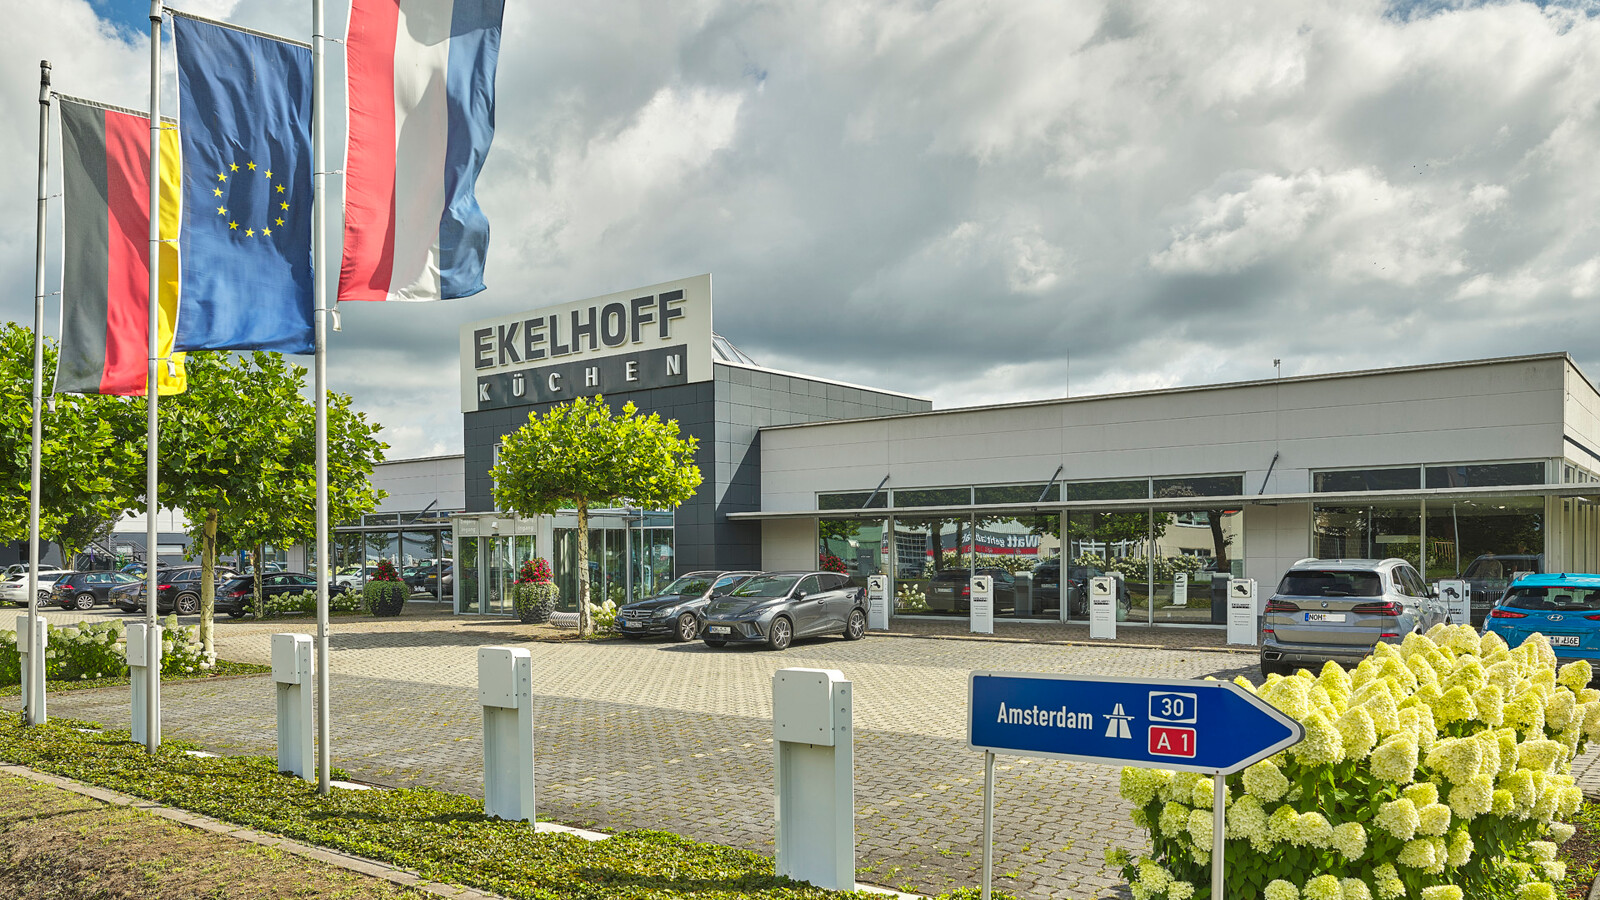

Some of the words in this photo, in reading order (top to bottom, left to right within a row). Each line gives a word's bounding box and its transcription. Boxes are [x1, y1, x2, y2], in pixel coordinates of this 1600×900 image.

[474, 289, 686, 369] EKELHOFF
[479, 354, 681, 401] KÜCHEN
[997, 702, 1093, 730] Amsterdam
[1161, 698, 1184, 717] 30
[1157, 732, 1171, 750] A
[1181, 733, 1188, 752] 1
